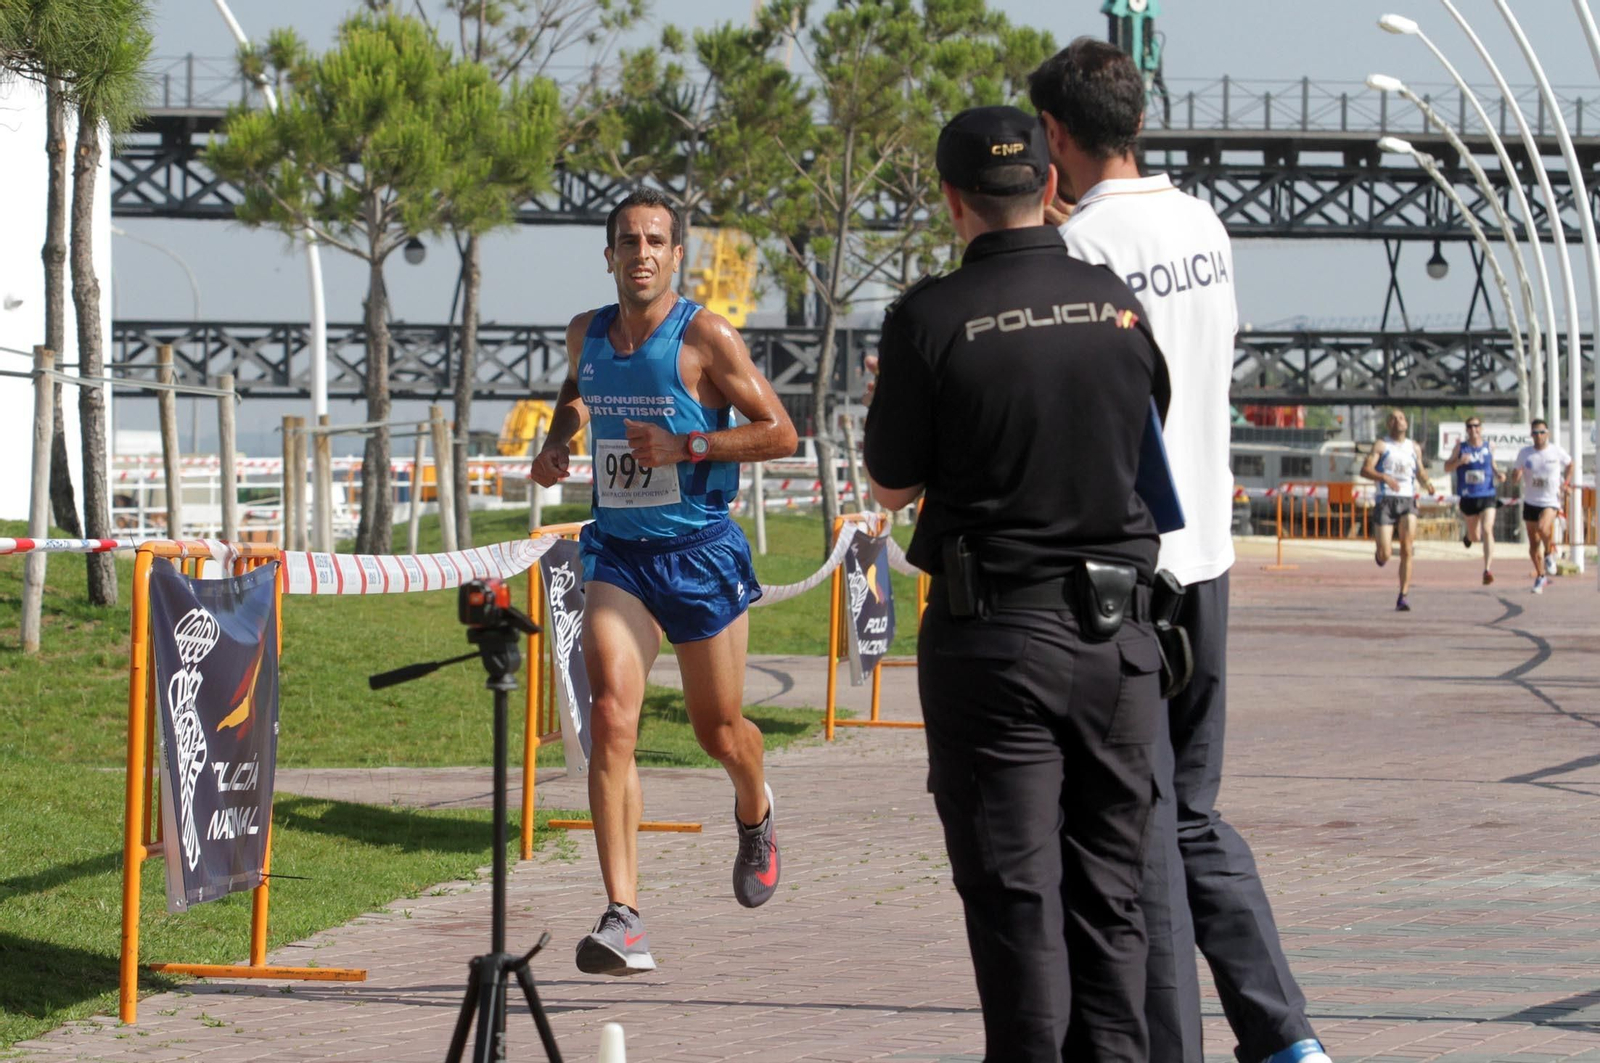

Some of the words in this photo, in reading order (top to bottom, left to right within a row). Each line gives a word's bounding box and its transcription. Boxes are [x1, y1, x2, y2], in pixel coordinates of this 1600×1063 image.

[991, 143, 1025, 156] CNP
[1126, 251, 1230, 298] POLICIA
[965, 302, 1118, 342] POLICIA
[594, 406, 676, 416] ATLETISMO
[603, 395, 675, 405] ONUBENSE
[606, 452, 653, 489] 999
